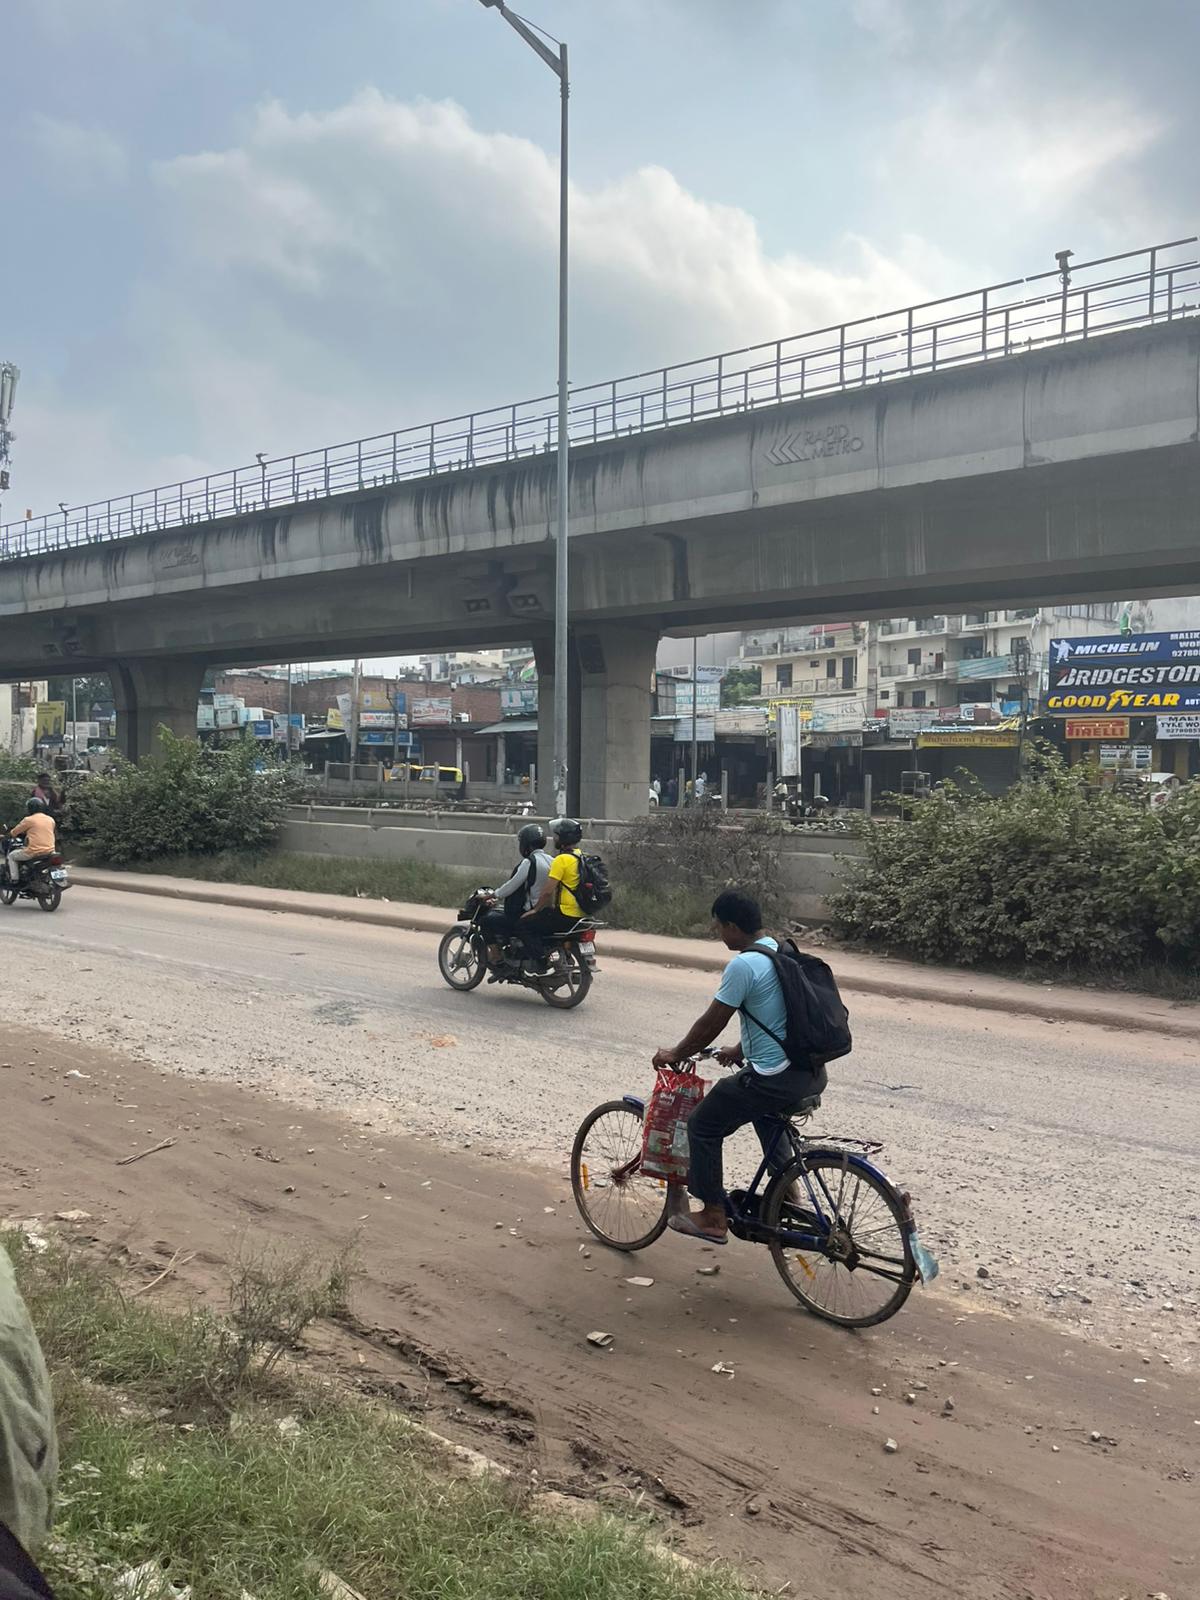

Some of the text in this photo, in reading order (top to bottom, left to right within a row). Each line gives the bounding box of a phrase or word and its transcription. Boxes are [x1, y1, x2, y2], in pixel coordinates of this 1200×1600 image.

[812, 437, 864, 460] METRO
[1074, 641, 1160, 655] MICHELIN
[1171, 649, 1200, 657] 92780
[1056, 665, 1200, 686] BRIDGESTON
[1048, 691, 1180, 710] GOODYEAR
[1067, 720, 1125, 737] PIRELLI
